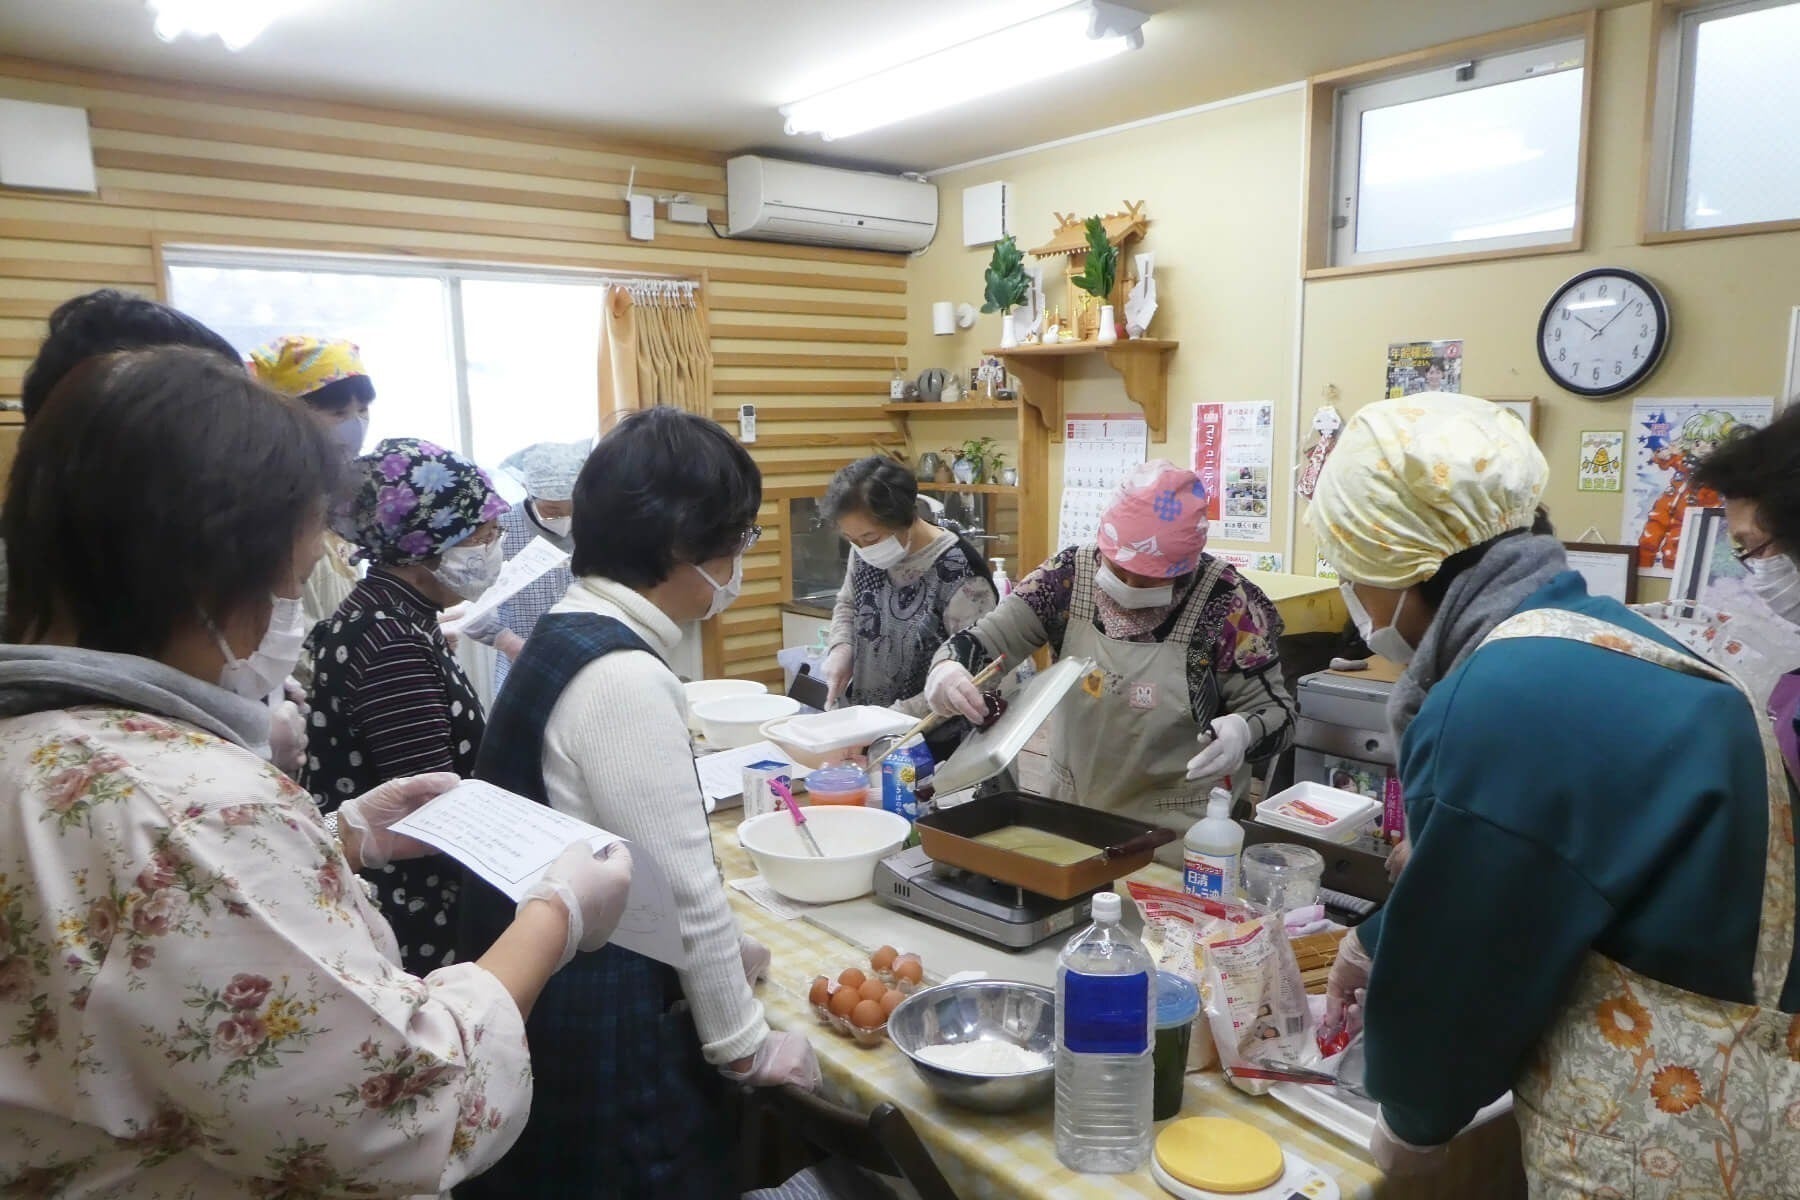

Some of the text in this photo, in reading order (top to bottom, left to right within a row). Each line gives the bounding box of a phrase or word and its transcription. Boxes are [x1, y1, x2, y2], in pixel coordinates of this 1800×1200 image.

[1561, 310, 1571, 321] 10
[1635, 303, 1643, 317] 2
[1554, 328, 1561, 342] 9
[1640, 324, 1648, 337] 3
[1559, 348, 1566, 361] 8
[1632, 345, 1638, 359] 4
[1572, 363, 1579, 377] 7
[1593, 367, 1600, 380] 6
[1614, 361, 1622, 375] 5
[1188, 870, 1208, 887] 日清
